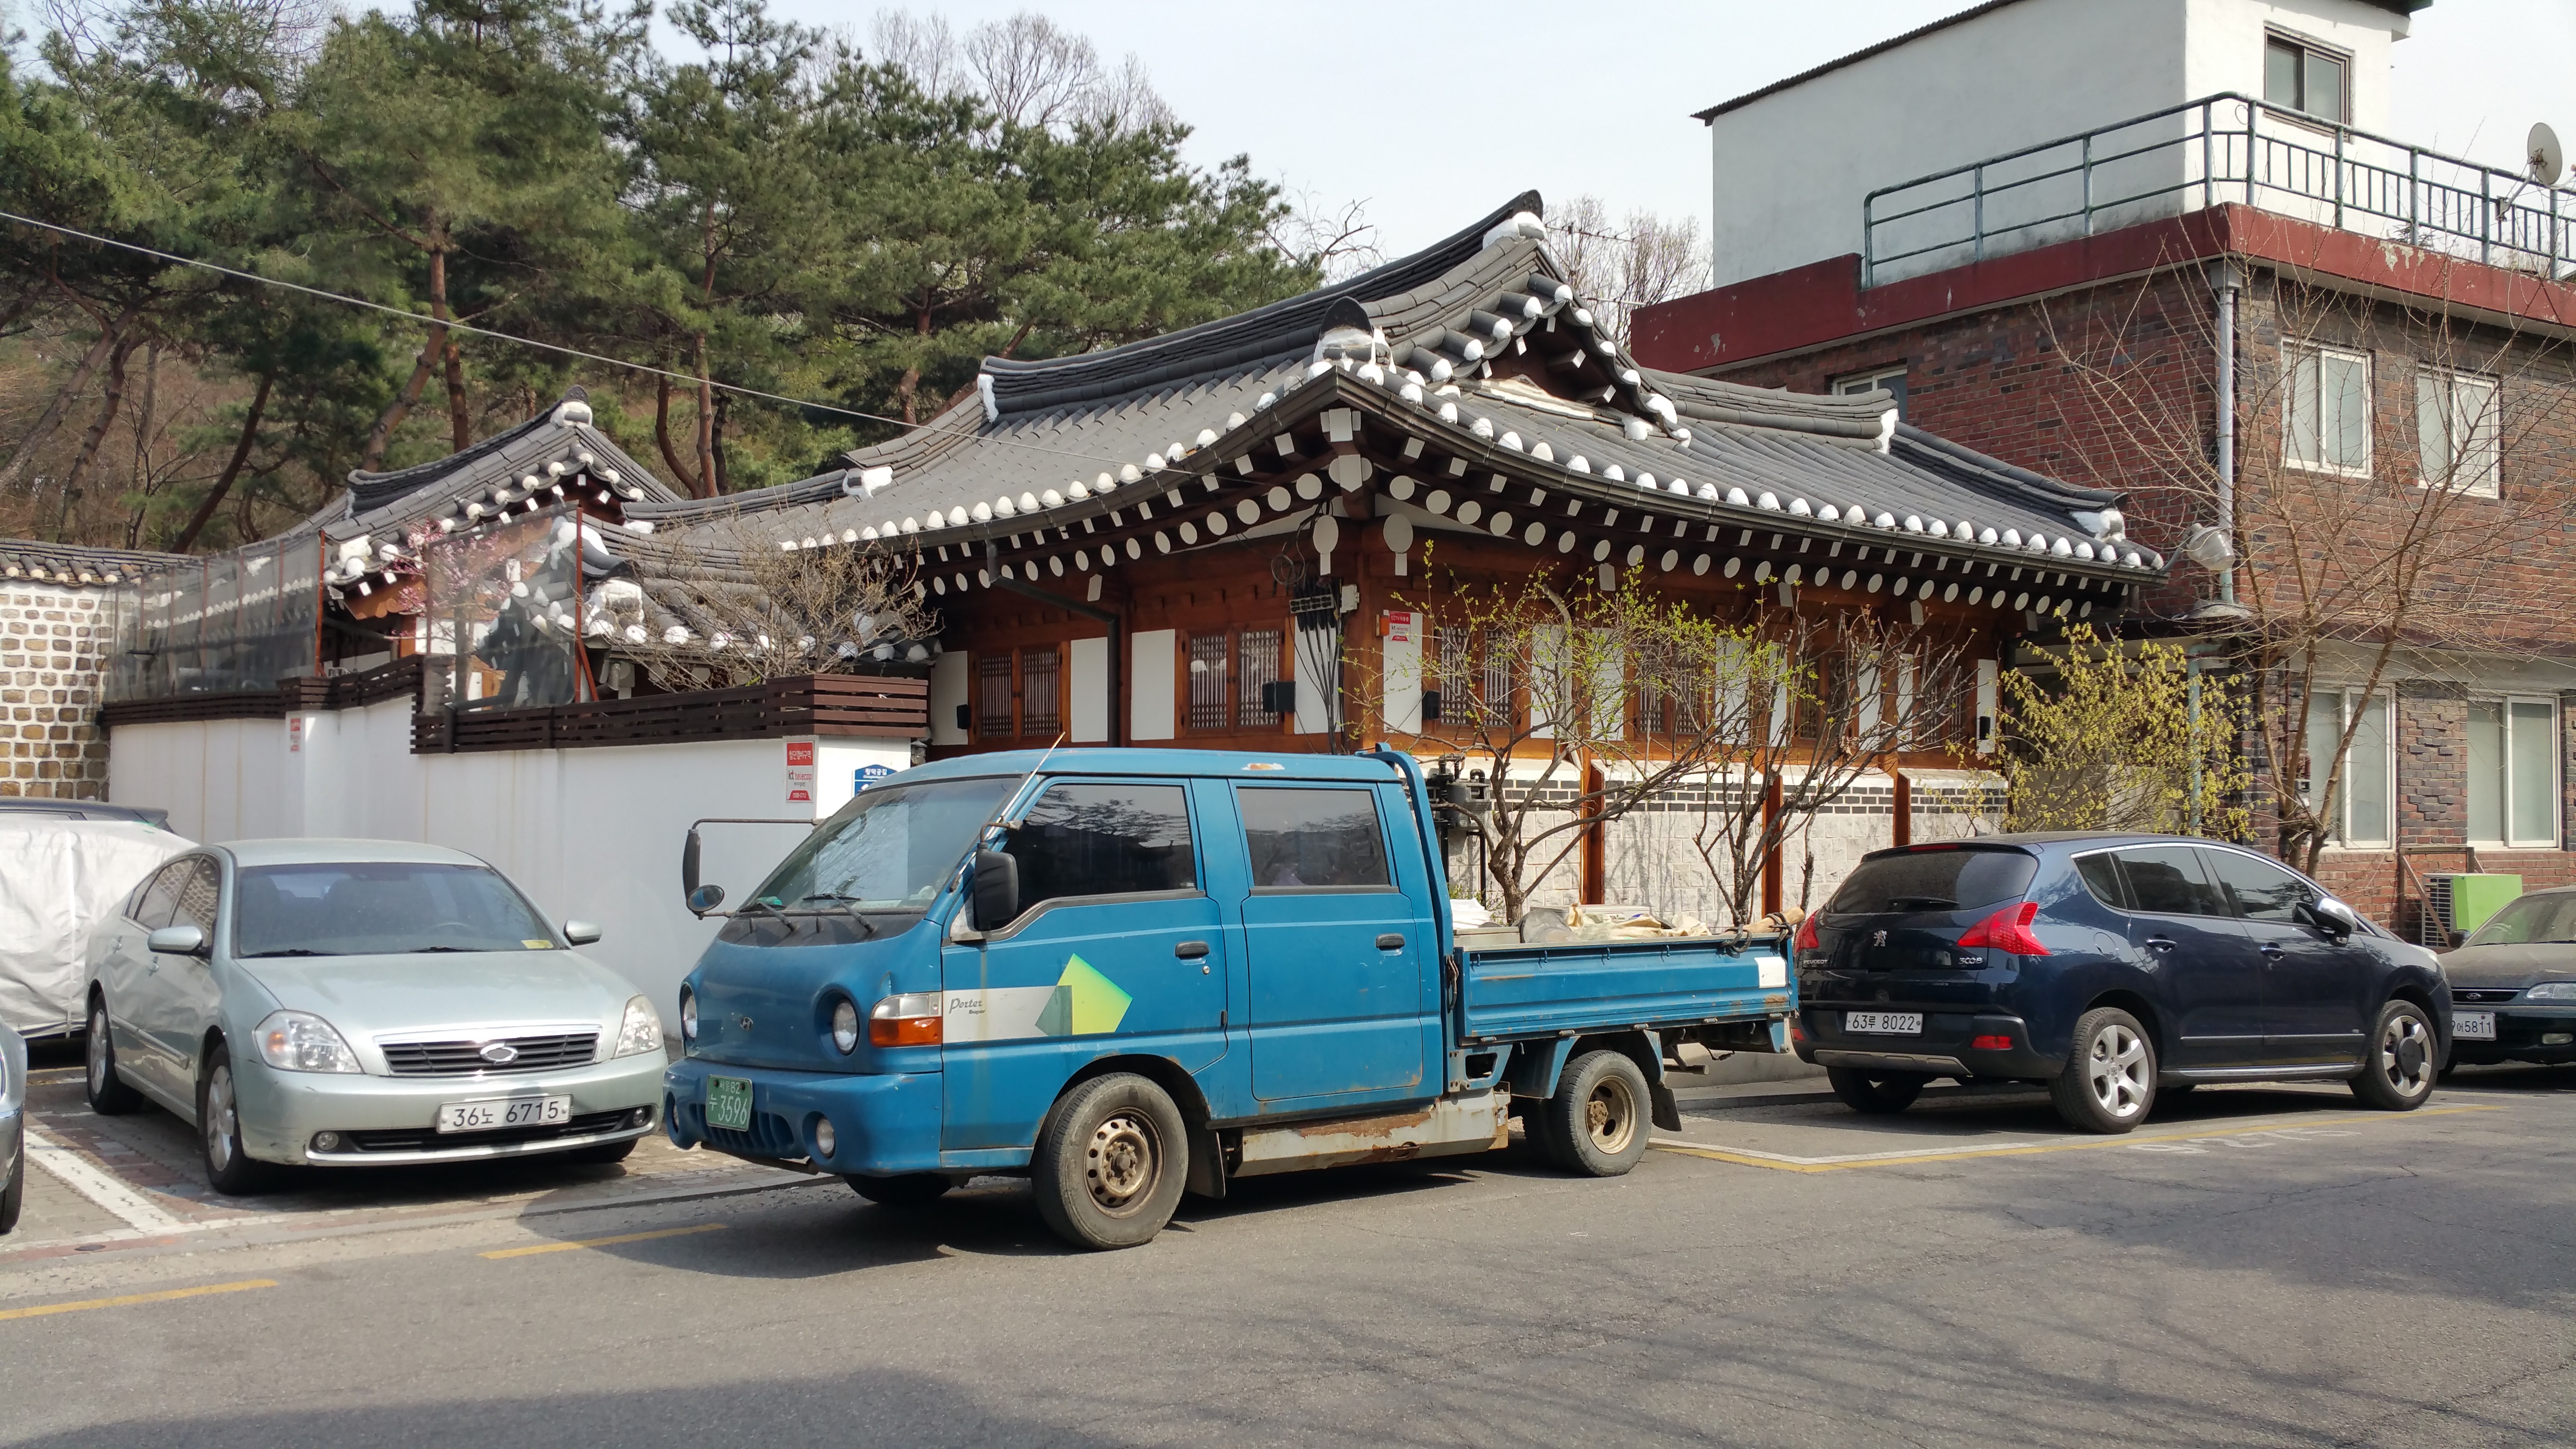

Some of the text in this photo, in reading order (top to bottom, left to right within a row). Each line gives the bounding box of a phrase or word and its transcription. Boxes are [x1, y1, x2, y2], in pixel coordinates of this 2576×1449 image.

[788, 770, 812, 782] kt telecop
[949, 998, 983, 1014] Porter
[1852, 1014, 1915, 1030] 63루 8022
[453, 1107, 494, 1127] 36노
[506, 1101, 559, 1123] 6715
[718, 1095, 748, 1125] 3596
